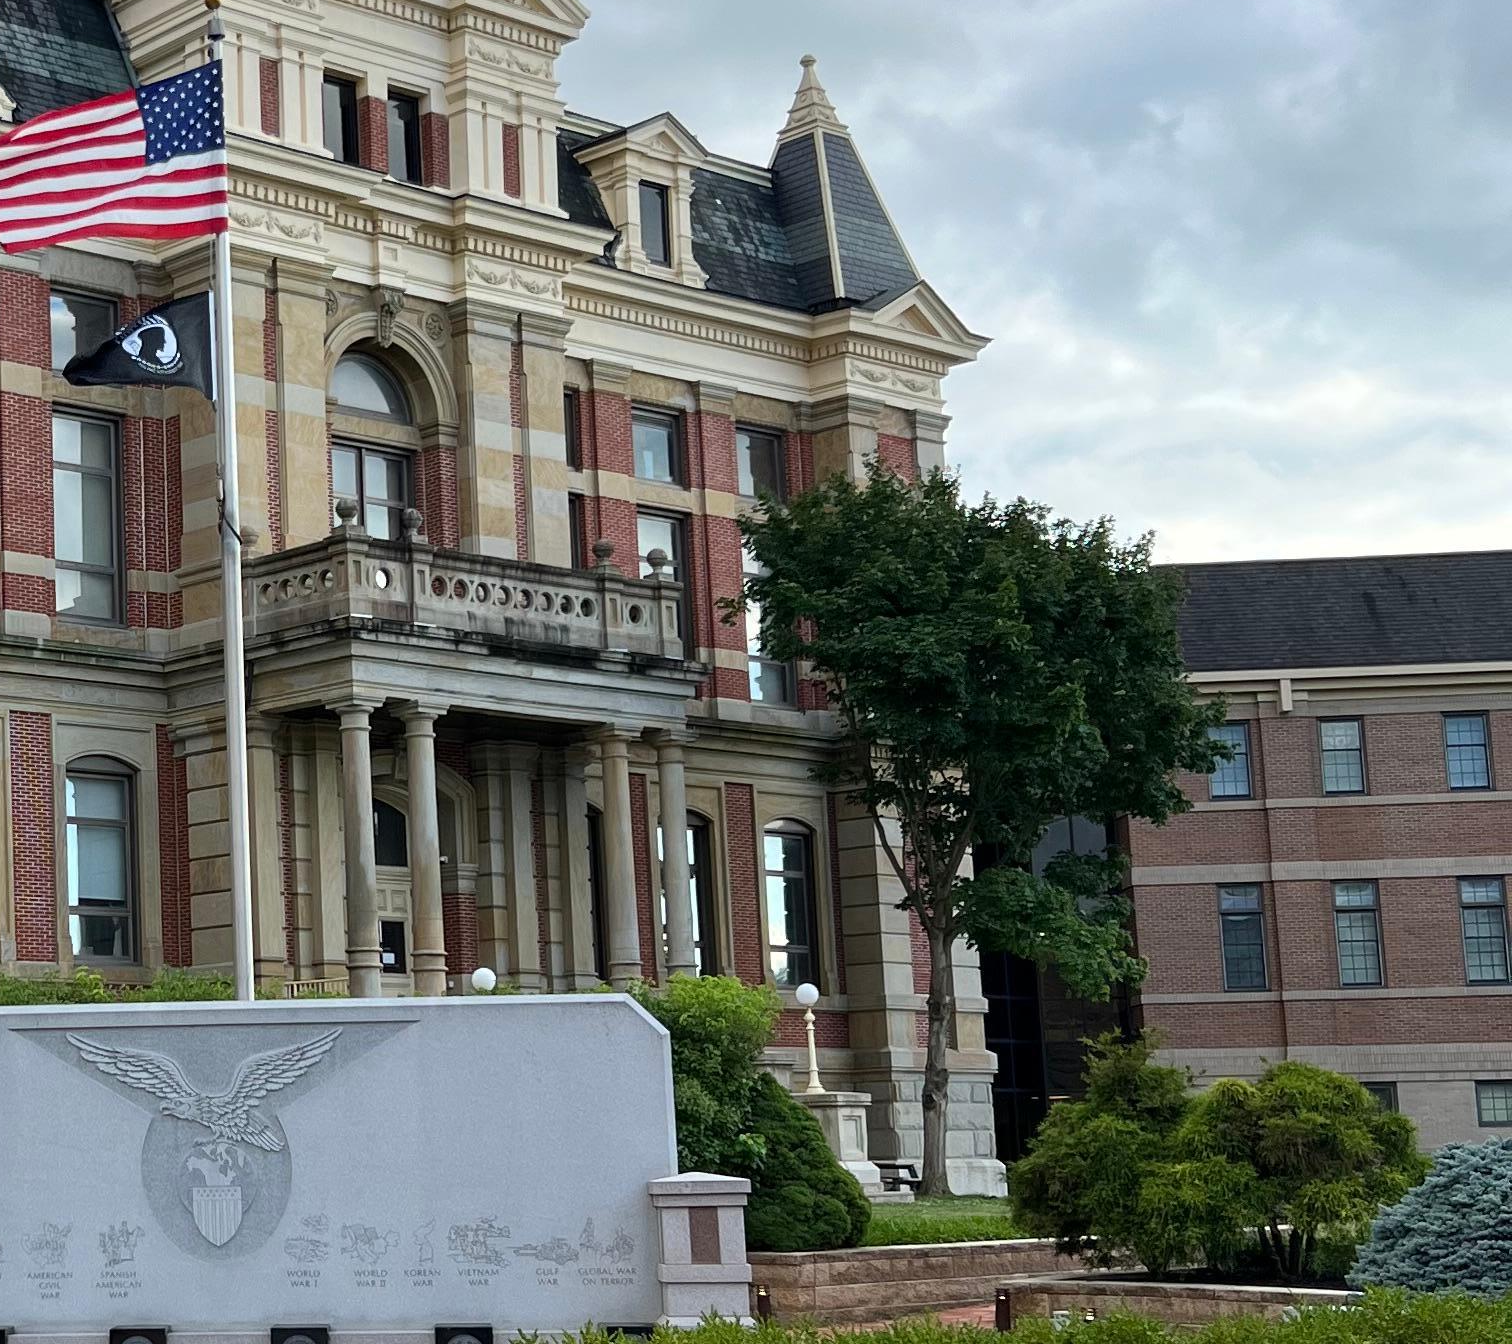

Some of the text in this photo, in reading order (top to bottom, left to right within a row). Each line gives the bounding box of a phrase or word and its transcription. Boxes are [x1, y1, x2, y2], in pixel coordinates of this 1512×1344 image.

[100, 1271, 137, 1279] SPANISH
[287, 1270, 321, 1278] WORLD
[353, 1269, 388, 1278] WORLD
[403, 1269, 441, 1277] KOREAN
[458, 1268, 500, 1277] VIETNAM
[535, 1268, 559, 1276] GULF
[577, 1267, 637, 1275] GLOBAL WAR
[26, 1272, 73, 1280] AMERICAN
[38, 1282, 61, 1290] CIVIL
[95, 1281, 142, 1289] AMERICAN
[291, 1280, 311, 1288] WAR
[356, 1280, 387, 1288] WAR II
[538, 1278, 559, 1286] WAR
[582, 1278, 634, 1286] ON TERROR
[109, 1291, 129, 1299] WAR
